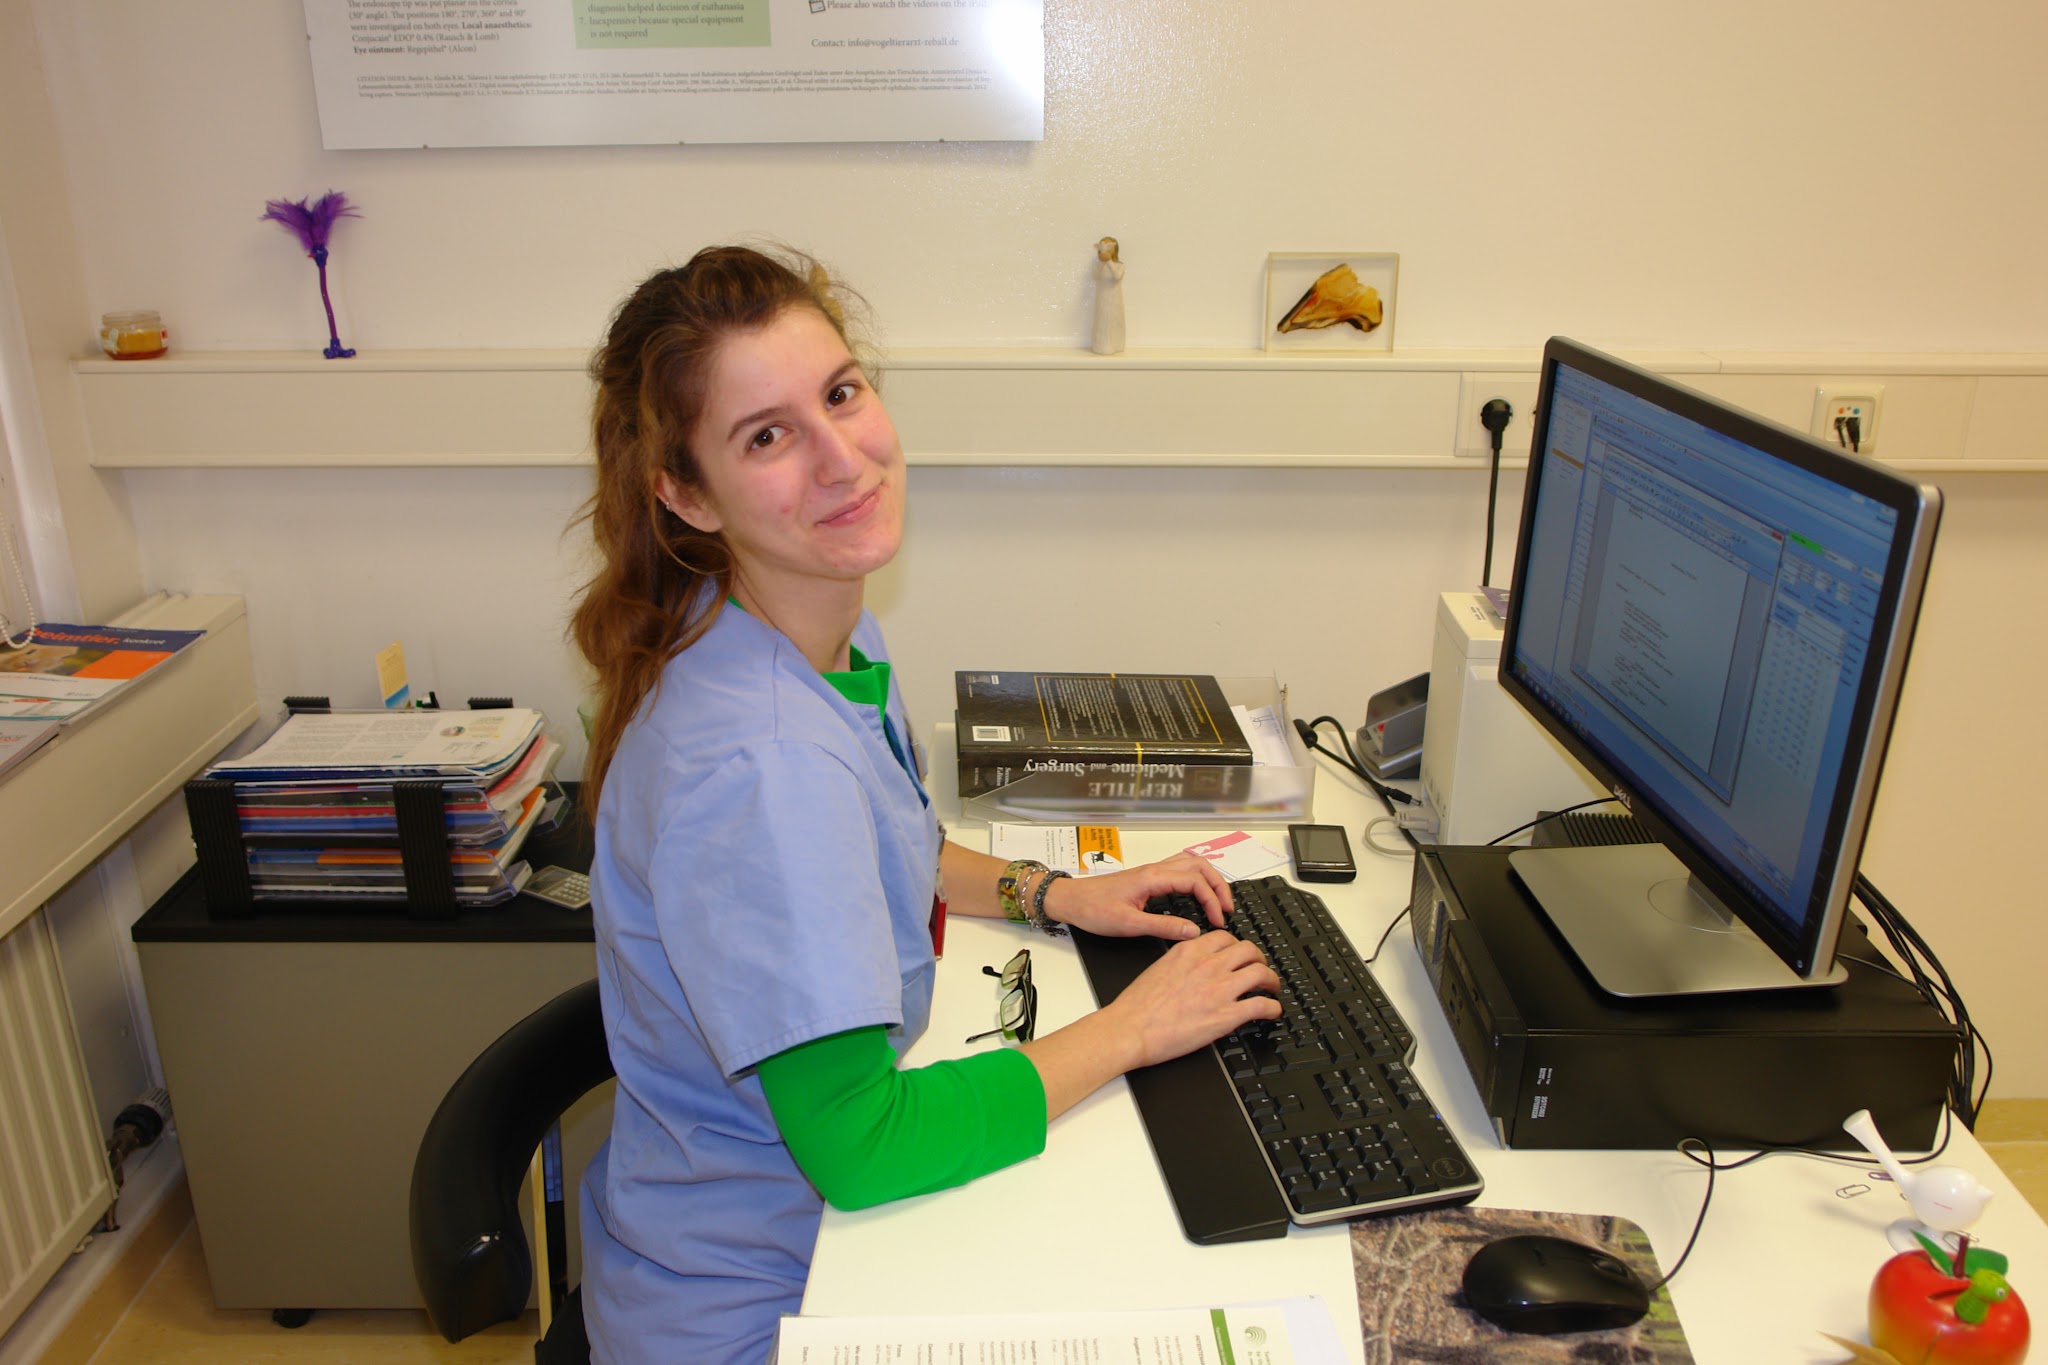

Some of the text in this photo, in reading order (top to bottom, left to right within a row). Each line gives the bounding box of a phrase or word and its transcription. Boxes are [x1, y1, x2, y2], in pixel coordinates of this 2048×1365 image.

[363, 0, 401, 9] endoscope
[430, 0, 441, 8] put
[588, 2, 744, 14] diagnosis helped decision of euthanasia
[827, 0, 852, 8] Please
[854, 0, 870, 8] also
[872, 0, 896, 8] watch
[407, 11, 439, 20] positions
[579, 16, 744, 26] 7. Inexpensive because special equipment
[370, 22, 412, 32] investigated
[614, 29, 648, 39] required
[811, 37, 959, 48] Contact: info@vogeltierarzt-reball.de
[354, 46, 367, 55] Eye
[449, 45, 477, 53] (Alcon)
[1023, 759, 1184, 778] Medicine and Surgery
[1089, 782, 1183, 798] REPTILE
[1614, 784, 1631, 809] DELL
